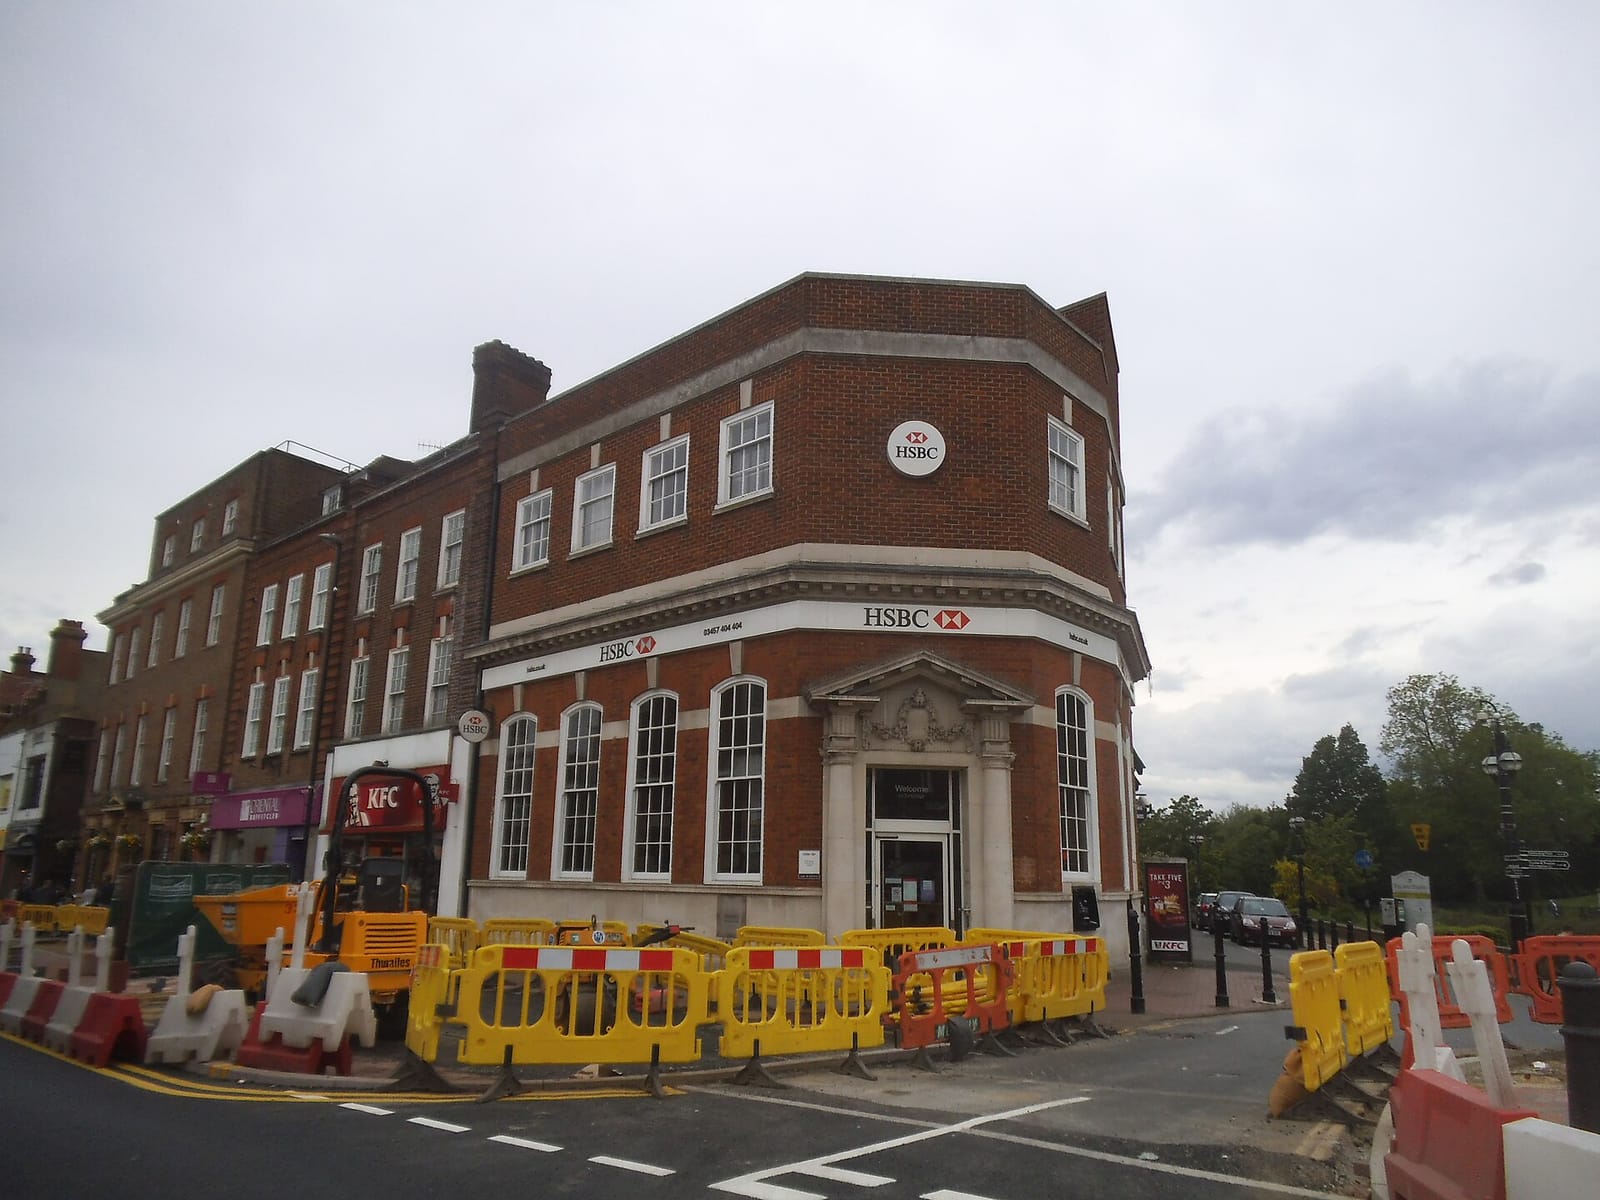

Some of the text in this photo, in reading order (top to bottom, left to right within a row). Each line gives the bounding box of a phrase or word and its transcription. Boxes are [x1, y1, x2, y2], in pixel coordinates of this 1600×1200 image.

[896, 446, 938, 459] HSBC
[863, 608, 929, 628] HSBC
[720, 624, 731, 632] 404
[732, 621, 742, 630] 404
[600, 640, 634, 662] HSBC
[463, 725, 487, 734] HSBC
[894, 784, 929, 793] Welcome
[367, 786, 399, 809] KFC
[1167, 874, 1183, 882] FIVE
[1163, 942, 1185, 950] KFC
[371, 958, 411, 969] Thwaites
